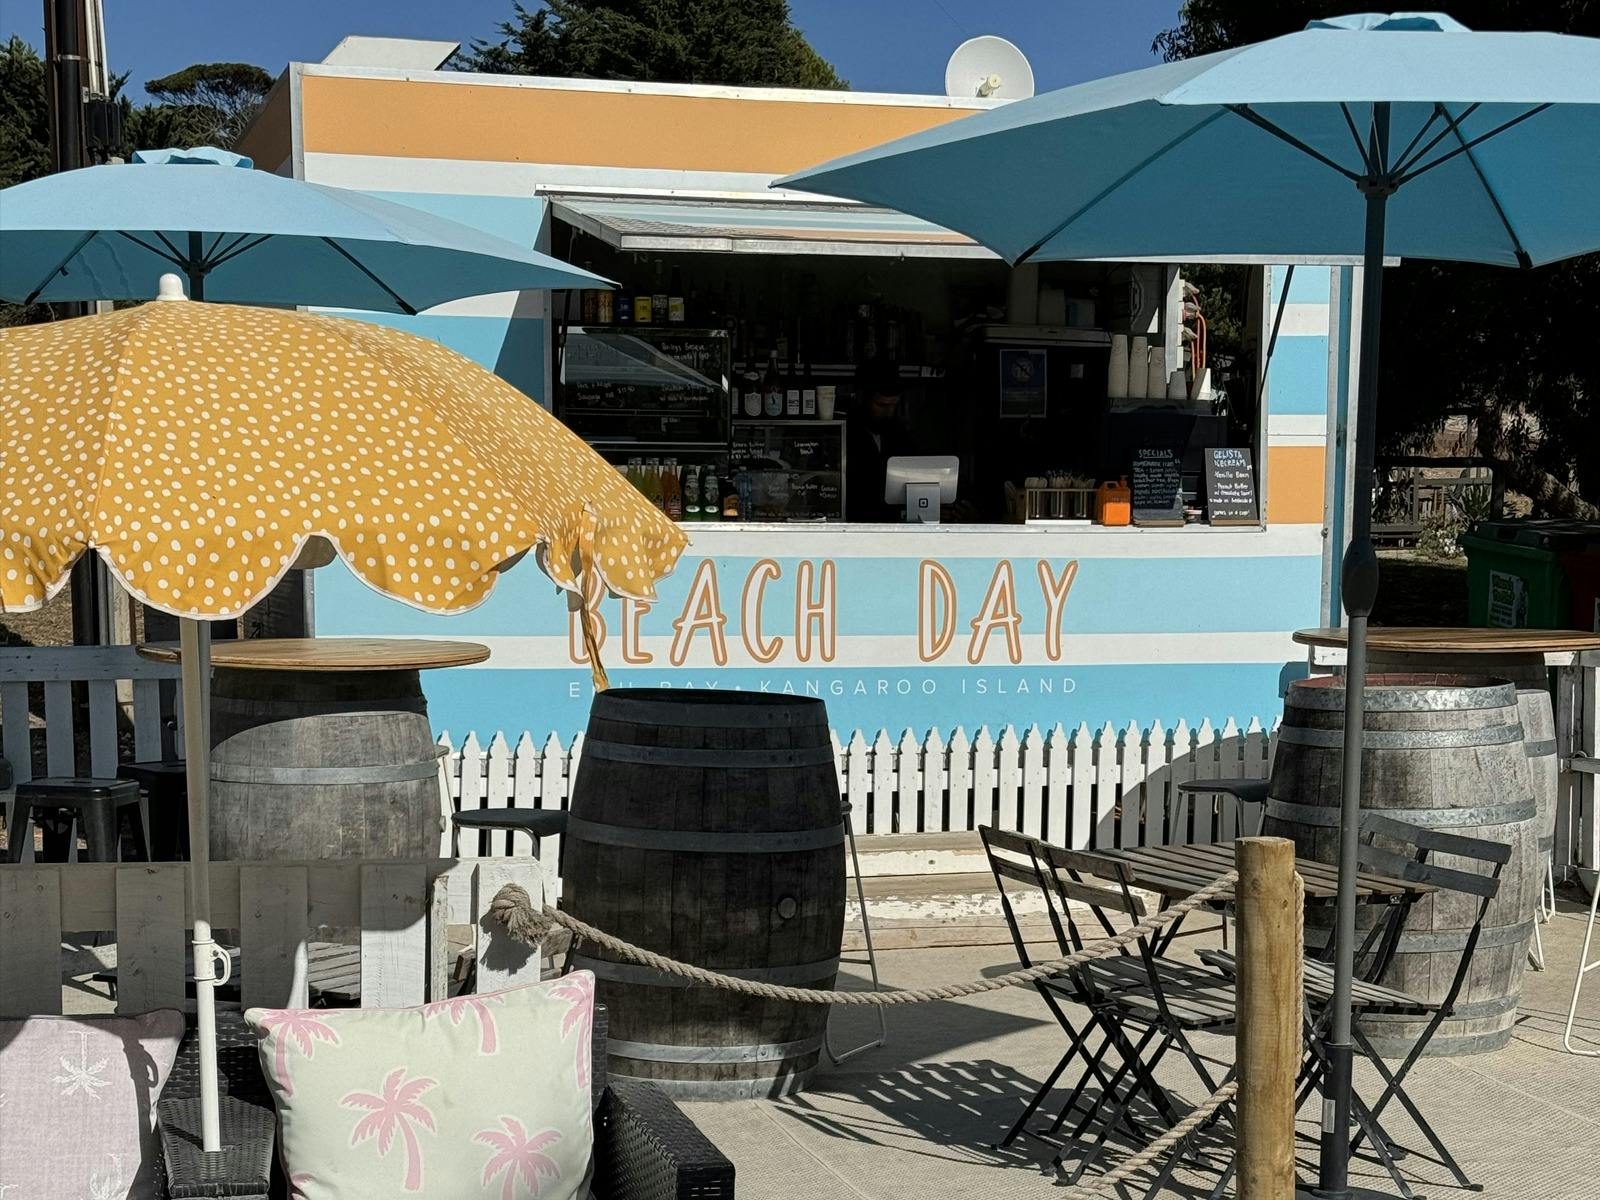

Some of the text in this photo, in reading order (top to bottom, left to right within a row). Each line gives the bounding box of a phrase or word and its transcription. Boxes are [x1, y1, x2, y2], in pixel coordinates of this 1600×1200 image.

[1138, 449, 1174, 459] SPECIALS
[569, 559, 1078, 666] BEACH DAY
[759, 677, 937, 696] KANGAROO
[961, 677, 1077, 695] ISLAND
